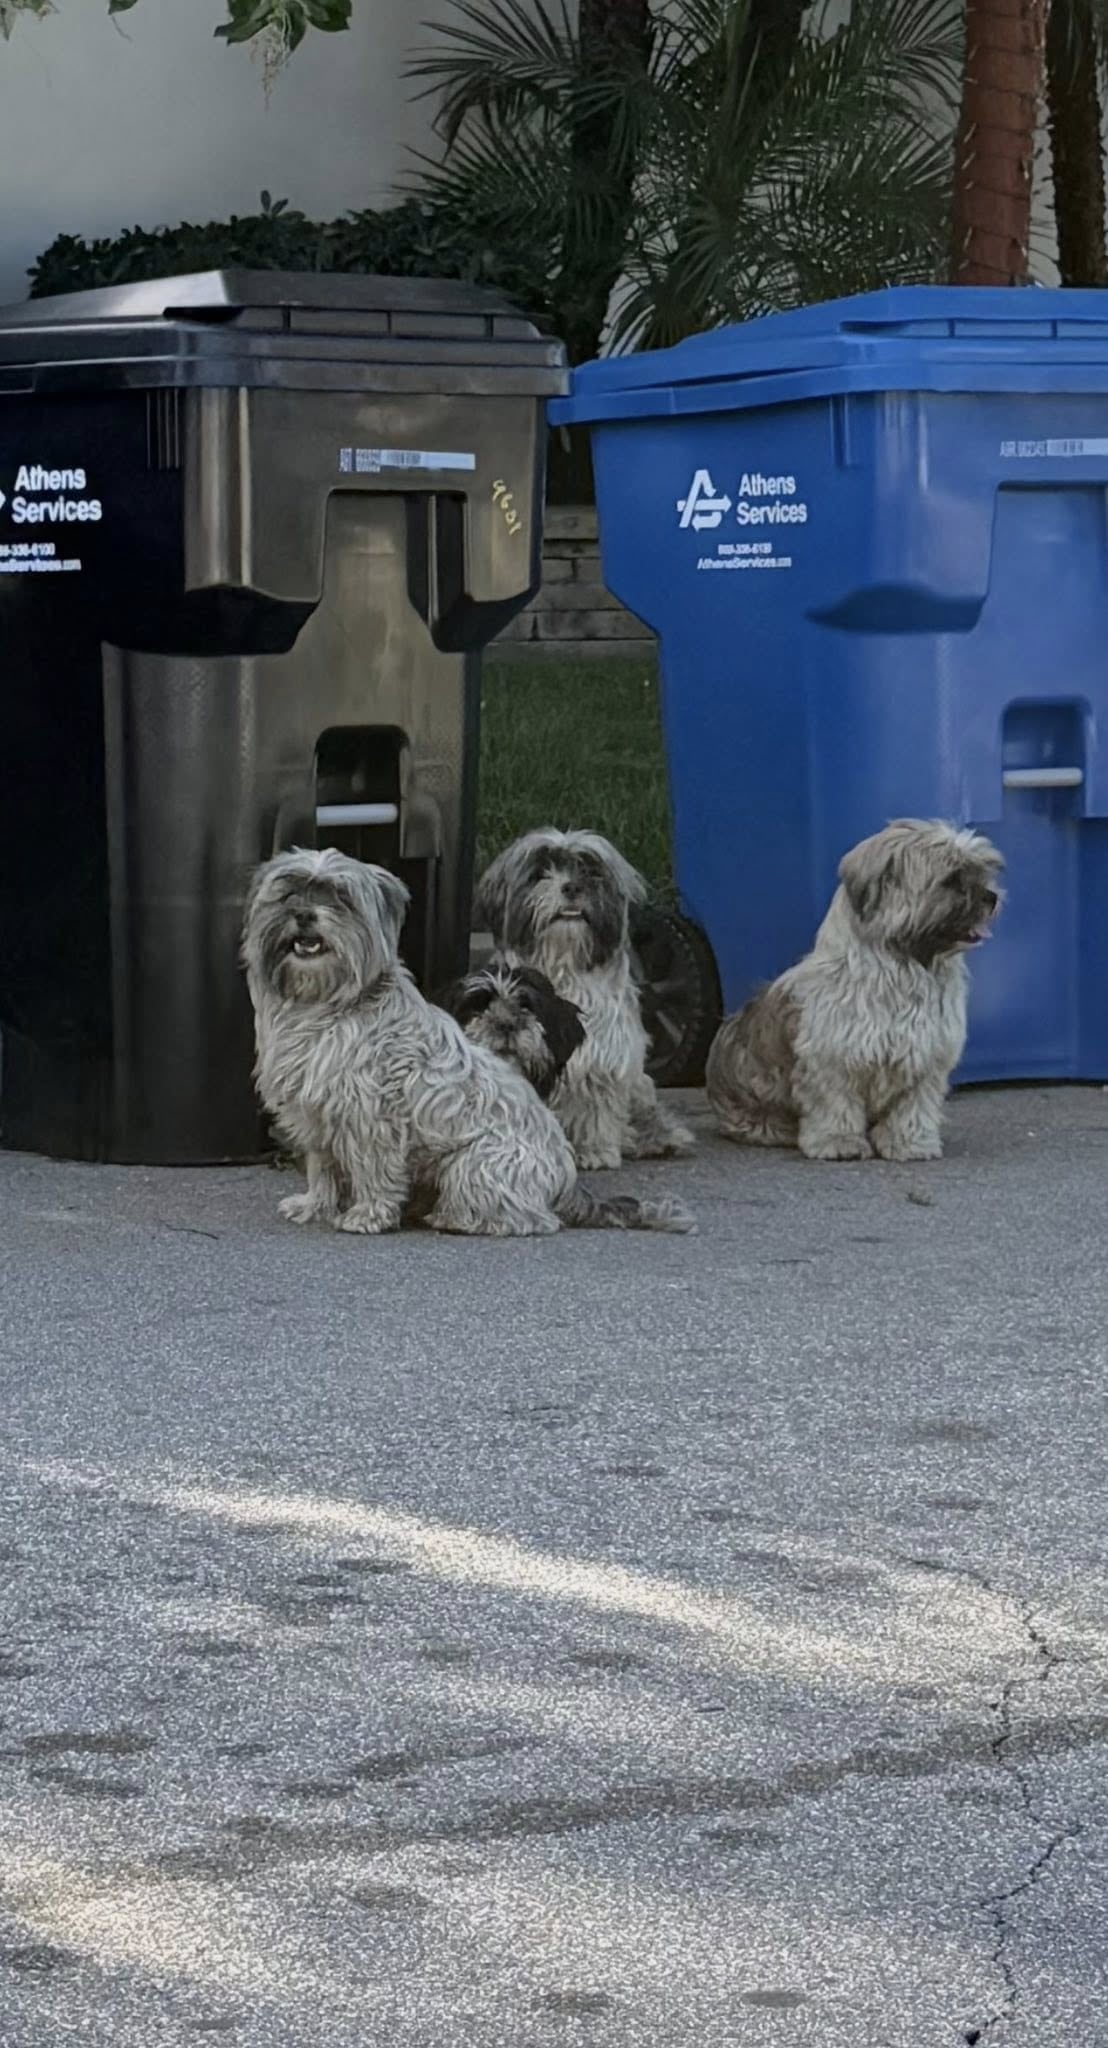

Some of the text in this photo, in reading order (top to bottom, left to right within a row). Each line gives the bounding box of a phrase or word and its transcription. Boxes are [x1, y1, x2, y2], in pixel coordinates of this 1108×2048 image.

[14, 464, 87, 492] Athens
[738, 472, 796, 497] Athens
[11, 495, 103, 523] Services
[736, 500, 808, 525] Services
